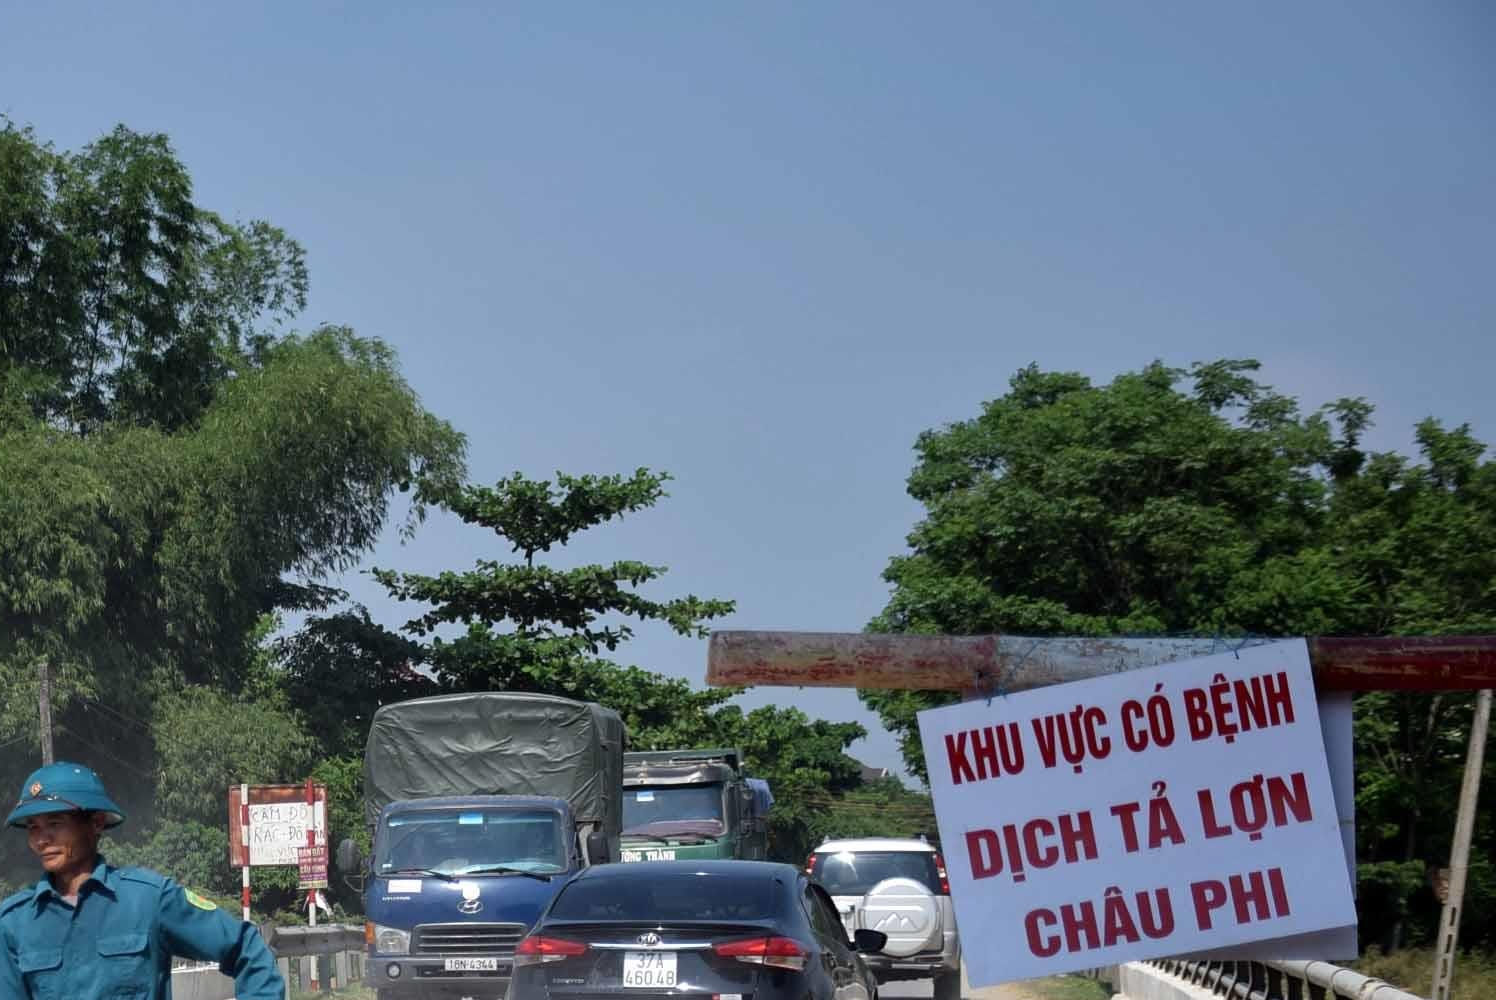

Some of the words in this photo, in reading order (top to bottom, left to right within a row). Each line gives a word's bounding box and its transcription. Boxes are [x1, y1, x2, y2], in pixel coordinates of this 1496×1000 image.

[944, 722, 1024, 785] KHU
[1032, 704, 1111, 774] VỰC
[1121, 683, 1175, 753] CÓ
[1183, 671, 1295, 744] BỆNH
[965, 810, 1099, 883] DỊCH
[1110, 781, 1185, 854] TẢ
[1197, 772, 1313, 841] LỢN
[639, 933, 659, 945] KIA
[1024, 886, 1175, 959] CHÂU
[1190, 868, 1290, 931] PHI
[636, 952, 664, 969] 37A
